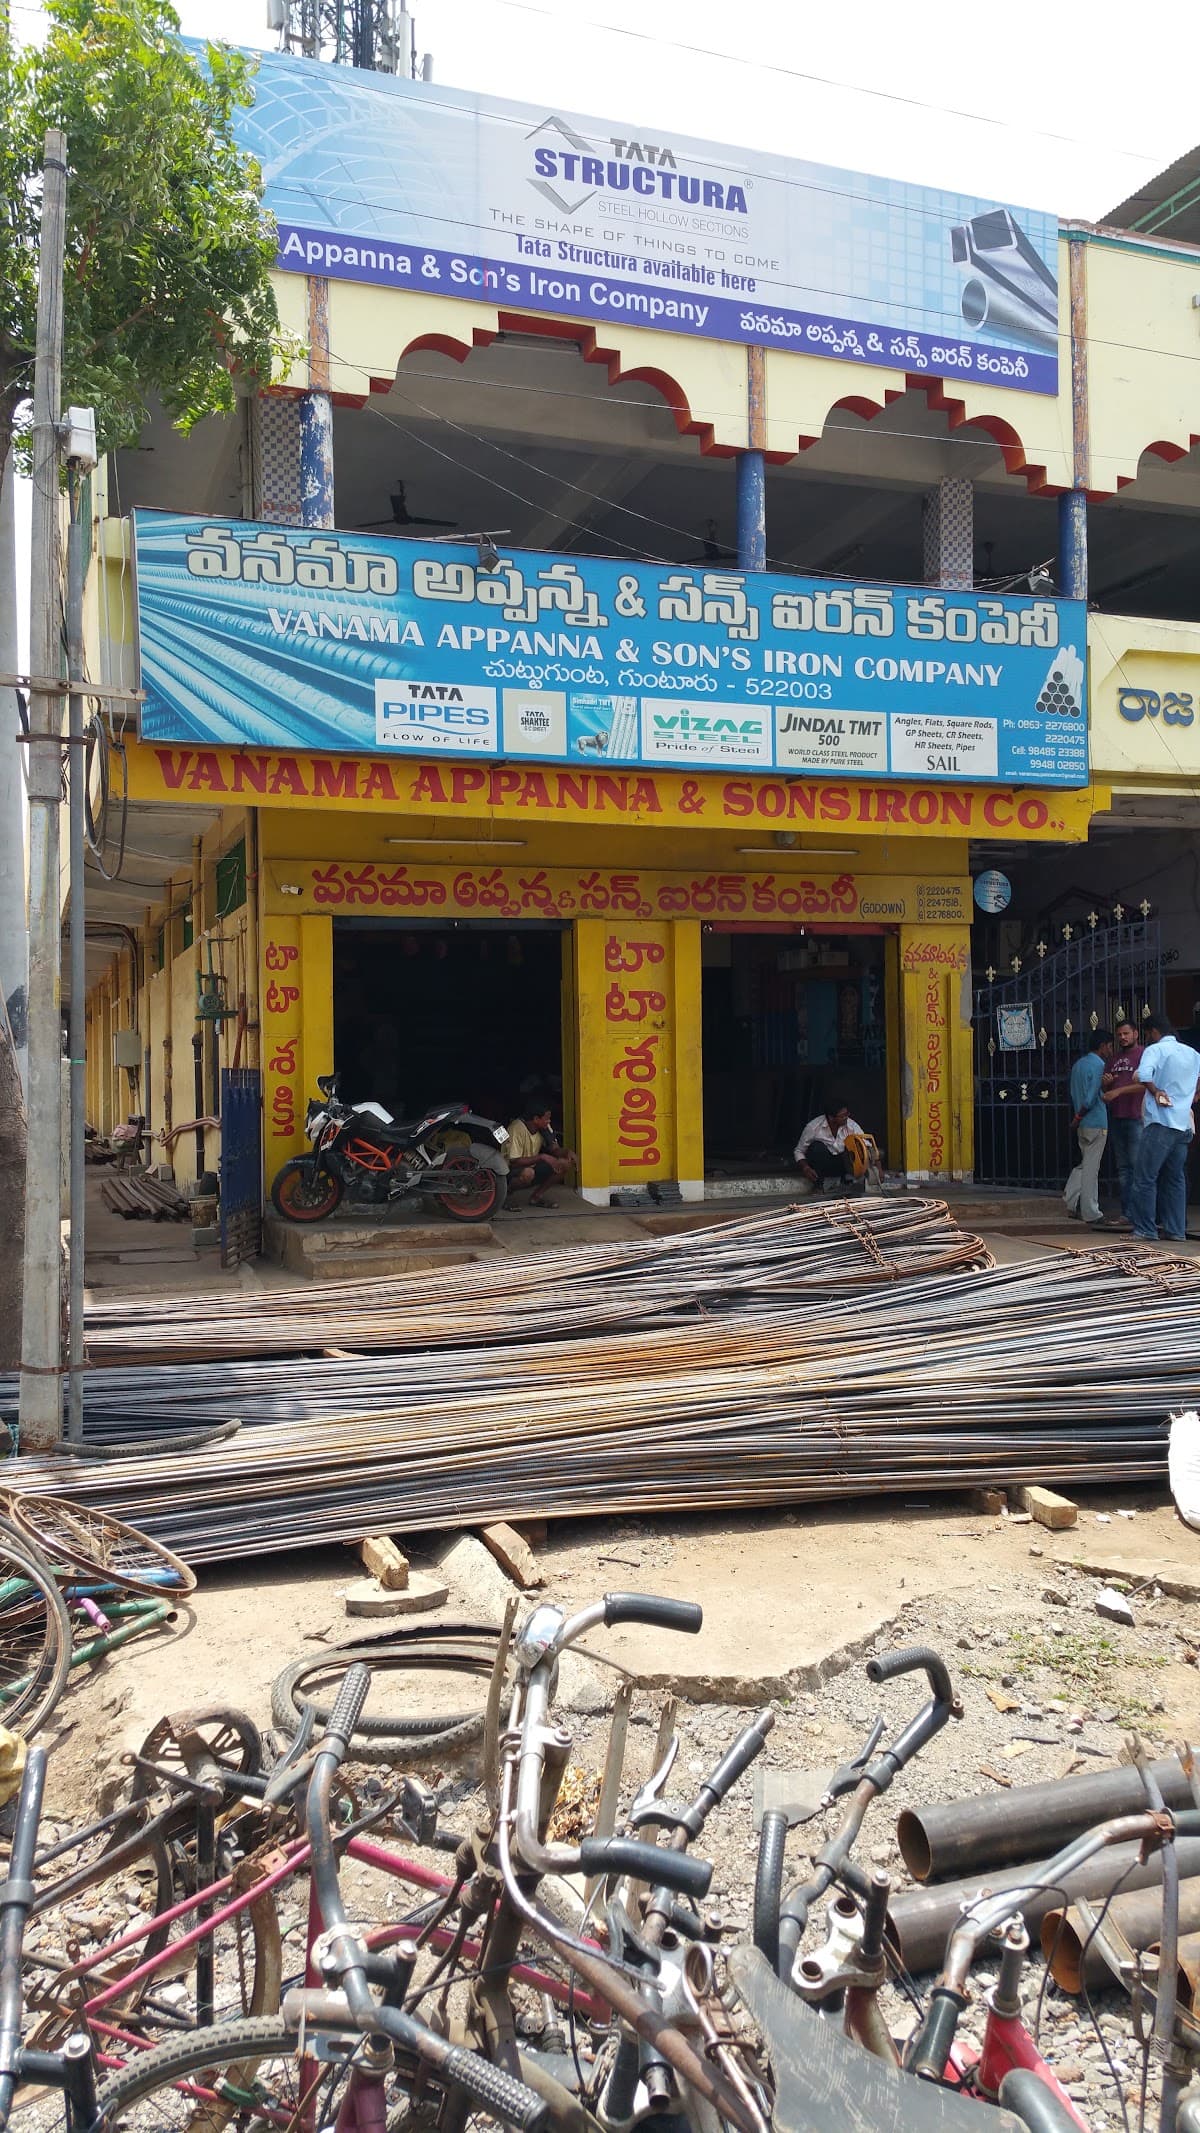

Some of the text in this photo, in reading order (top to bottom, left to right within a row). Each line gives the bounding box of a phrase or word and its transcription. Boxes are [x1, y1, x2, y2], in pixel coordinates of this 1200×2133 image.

[610, 137, 677, 169] TATA
[534, 147, 748, 214] STRUCTURA
[598, 200, 749, 239] STEEL HOLLOW SECTIONS
[489, 208, 780, 271] THE SHAPE OF THINGS TO COME
[515, 233, 756, 293] Tata Structura available here
[283, 232, 709, 327] Appanna & Son's Iron Company
[740, 311, 1029, 378] వనమా అప్పన్న & సన్స్ ఐరన్ కంపెనీ
[186, 526, 1059, 648] వనమా అప్పన్న & సన్స్ ఐరన్ కంపెనీ
[267, 607, 1003, 687] VANAMA APPANNA & SON'S IRON COMPANY
[408, 684, 464, 702] TATA
[618, 668, 718, 693] గుంటూరు
[745, 677, 832, 701] 522003
[383, 701, 490, 727] PIPES
[1118, 687, 1200, 728] రాజ
[849, 720, 882, 736] TMT
[894, 717, 995, 730] Angles, Flats, Square Rods,
[1003, 719, 1016, 729] Ph:
[1045, 721, 1085, 732] 2276800
[383, 732, 490, 746] FLOW OF LIFE
[653, 731, 762, 744] STEEL
[818, 735, 840, 746] 500
[905, 729, 984, 741] GP Sheets, CR Sheets,
[1045, 734, 1085, 745] 2220475
[656, 742, 697, 751] Pride
[720, 745, 760, 754] Steel
[788, 748, 878, 759] WORLD CLASS STEEL PRODUCT
[914, 741, 976, 753] HR Sheets, Pipes
[1028, 746, 1056, 757] 98485
[927, 755, 961, 772] SAIL
[1057, 761, 1086, 771] 02850
[155, 749, 400, 801] VANAMA
[411, 765, 664, 814] APPANNA
[678, 779, 707, 815] &
[311, 863, 447, 906] వనమా
[453, 868, 562, 918] అప్పన్న
[578, 871, 653, 918] సన్స్
[656, 874, 747, 915] ఐరన్
[752, 873, 859, 915] కంపెనీ
[860, 897, 906, 919] (GODOWN)
